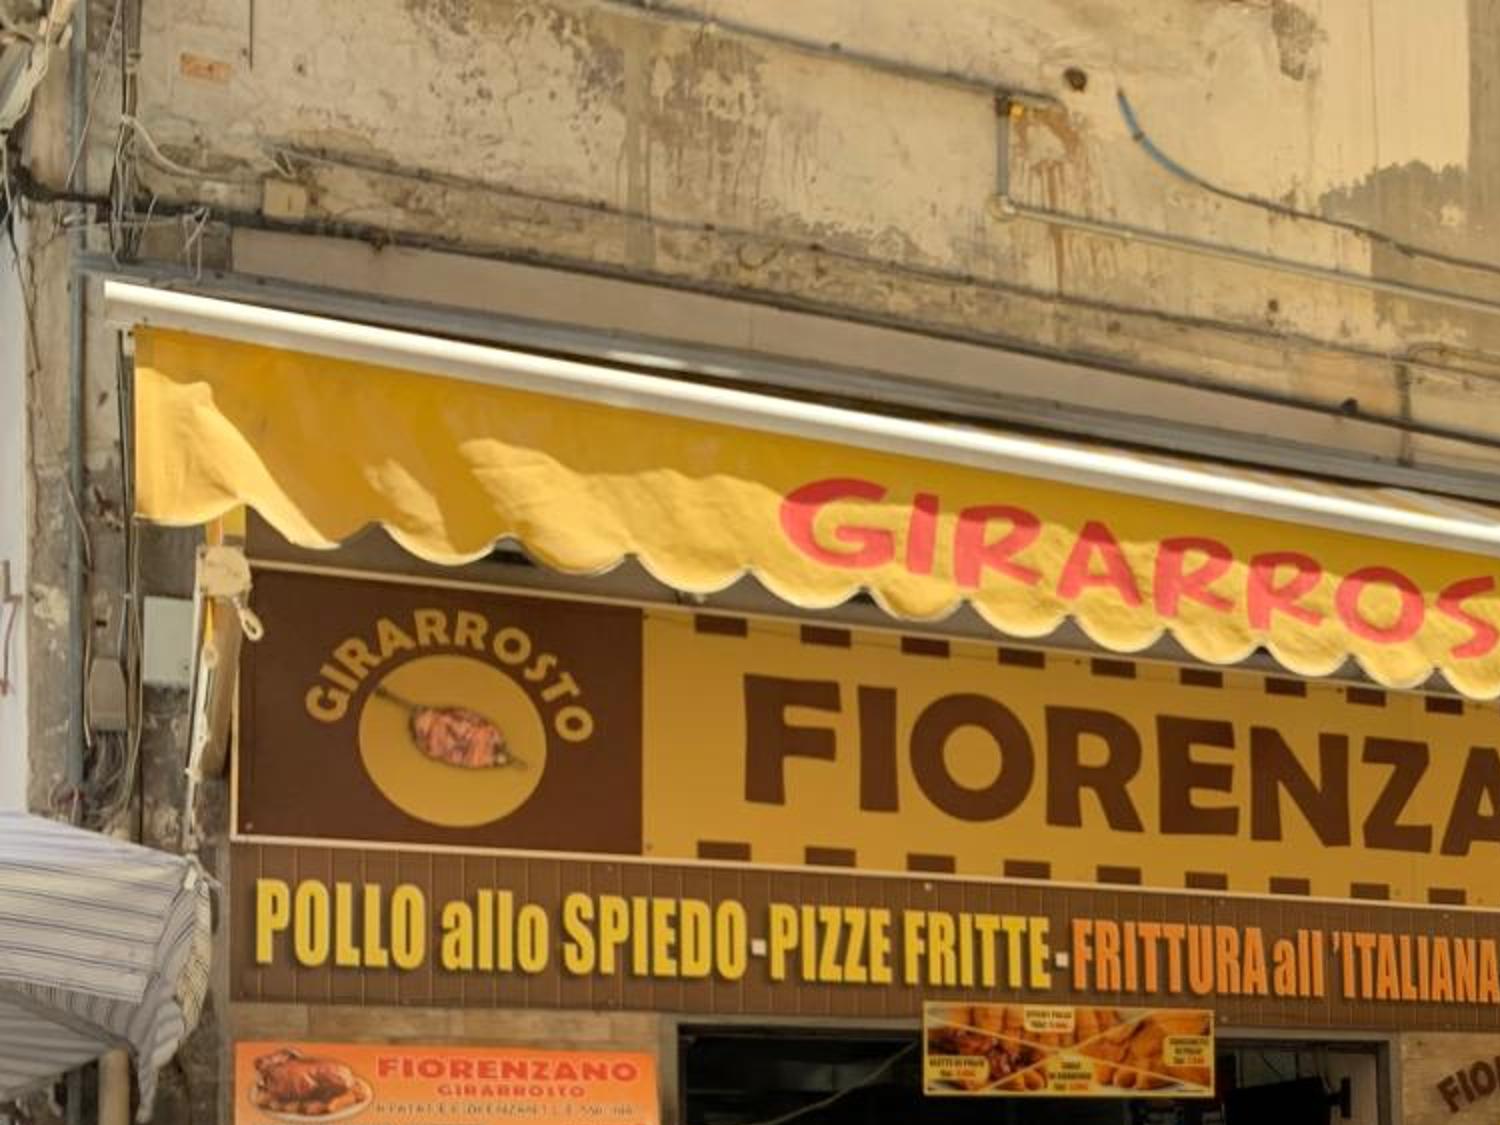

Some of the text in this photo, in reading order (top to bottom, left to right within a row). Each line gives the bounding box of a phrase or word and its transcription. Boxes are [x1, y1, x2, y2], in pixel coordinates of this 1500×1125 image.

[306, 607, 595, 743] GIRARROSTO
[255, 877, 427, 970] POLLO
[441, 887, 550, 974] allo
[376, 1056, 639, 1083] FIORENZANO
[436, 1083, 588, 1099] GIRARROSTO
